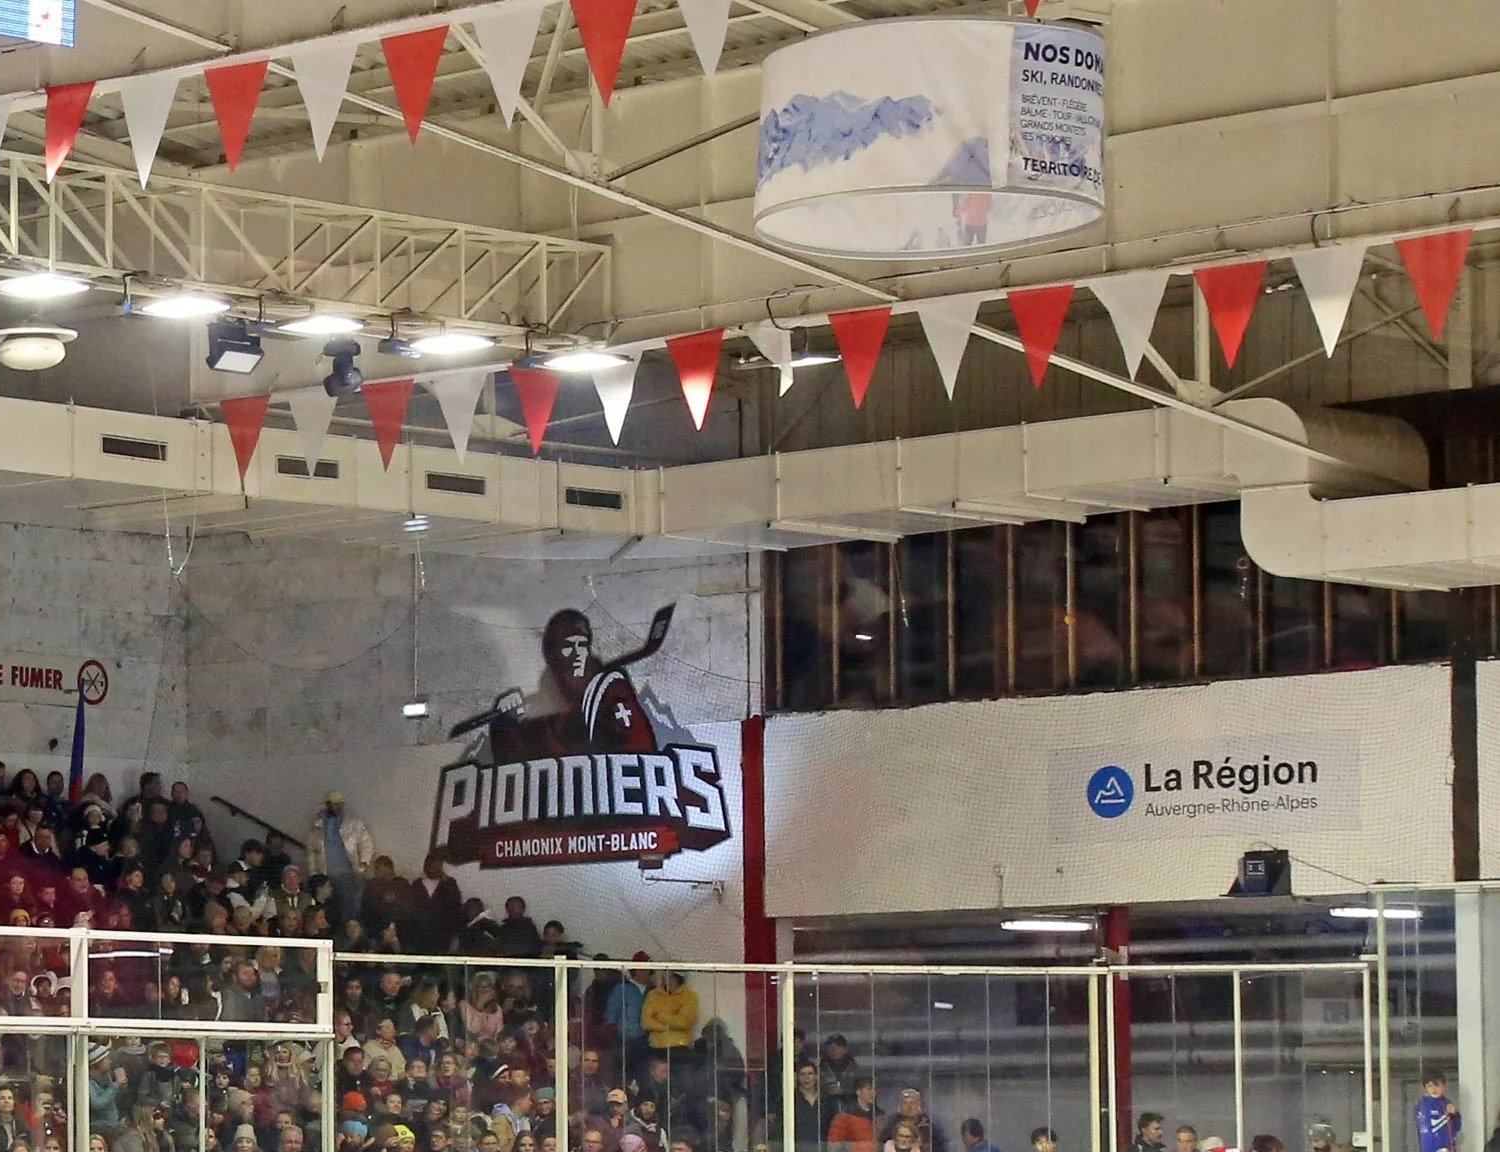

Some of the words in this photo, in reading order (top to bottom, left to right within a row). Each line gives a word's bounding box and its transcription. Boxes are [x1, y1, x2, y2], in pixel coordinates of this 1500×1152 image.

[1024, 42, 1070, 64] NOS
[1074, 48, 1104, 73] DOM
[1022, 69, 1047, 86] SKI,
[10, 665, 64, 691] FUMER
[1143, 762, 1183, 793] La
[1192, 755, 1319, 795] Région
[435, 747, 727, 848] PIONNIERS
[1144, 795, 1319, 818] Auvergne-Rhône-Alpes
[495, 837, 563, 859] CHAMONIX
[567, 830, 659, 853] MONT-BLANC
